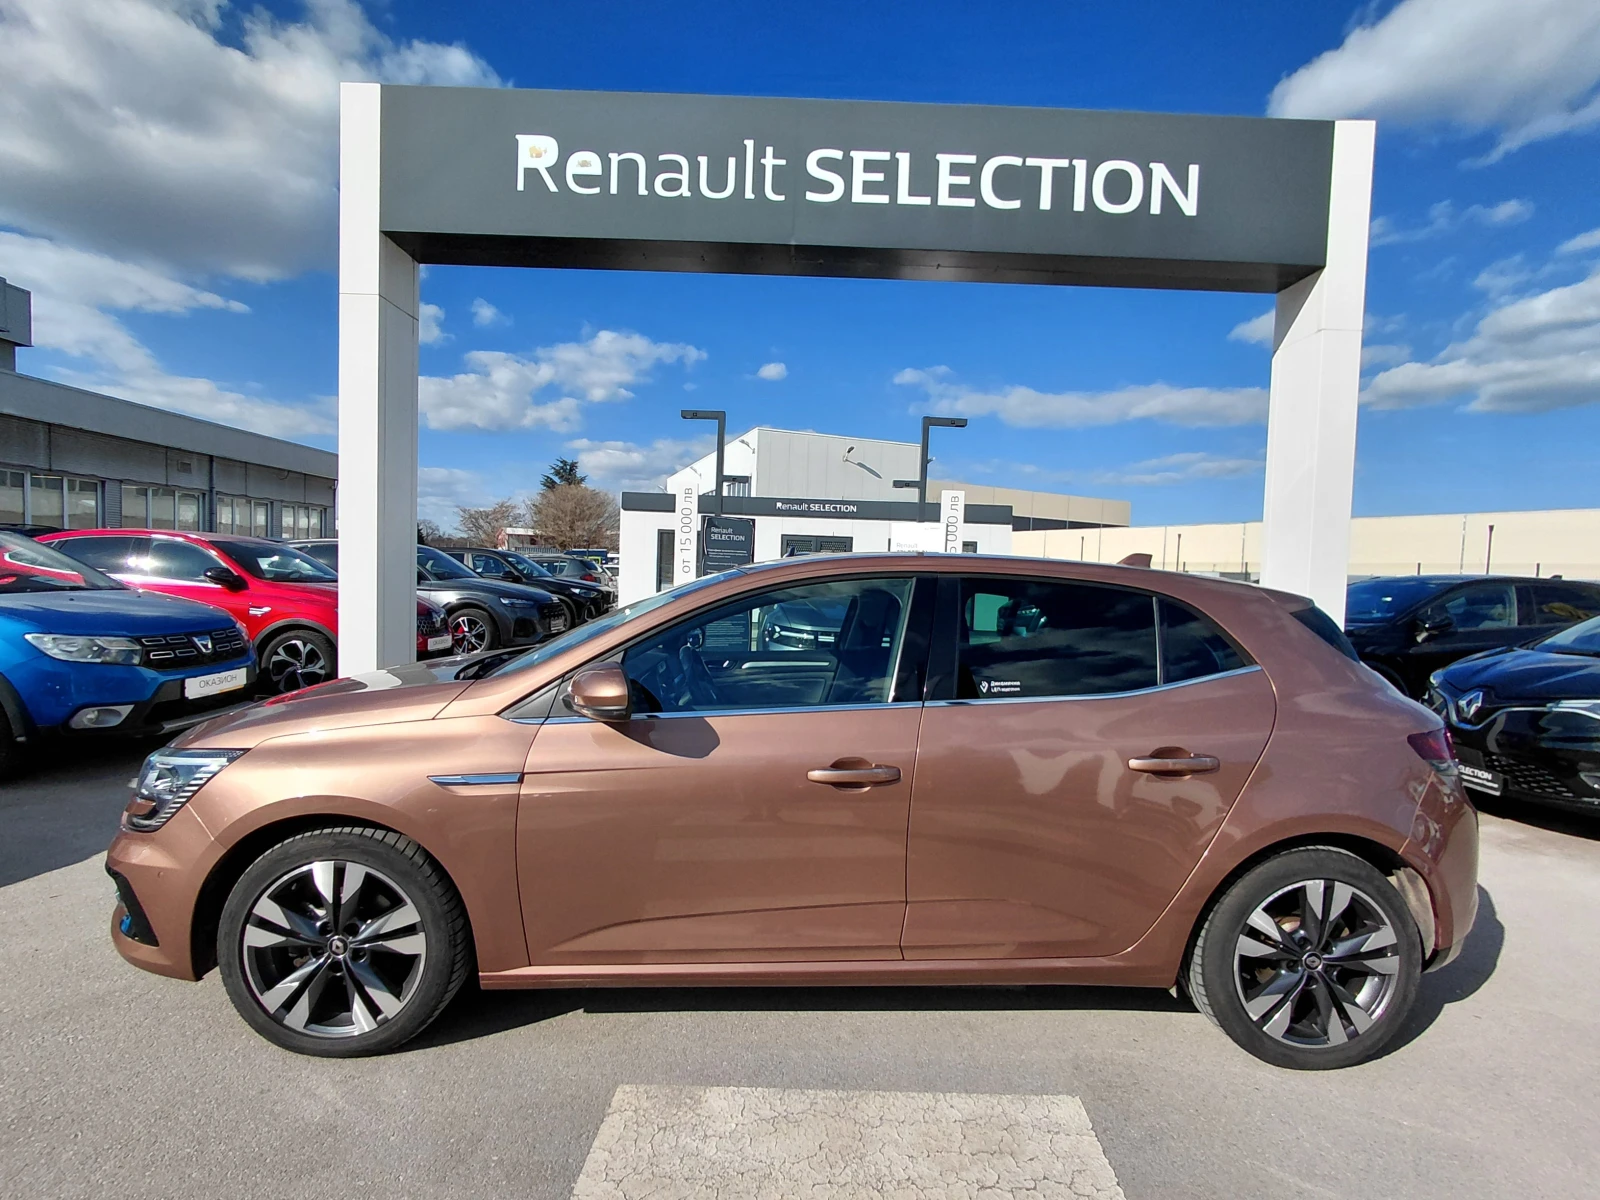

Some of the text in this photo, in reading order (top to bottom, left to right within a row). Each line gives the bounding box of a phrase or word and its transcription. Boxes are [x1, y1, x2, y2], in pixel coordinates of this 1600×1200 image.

[515, 134, 1200, 217] Renault SELECTION
[776, 501, 857, 513] Renault SELECTION
[681, 508, 692, 533] 000
[680, 538, 691, 553] 15
[199, 674, 237, 688] ОКАЗИОН
[1458, 765, 1493, 780] ELECTION
